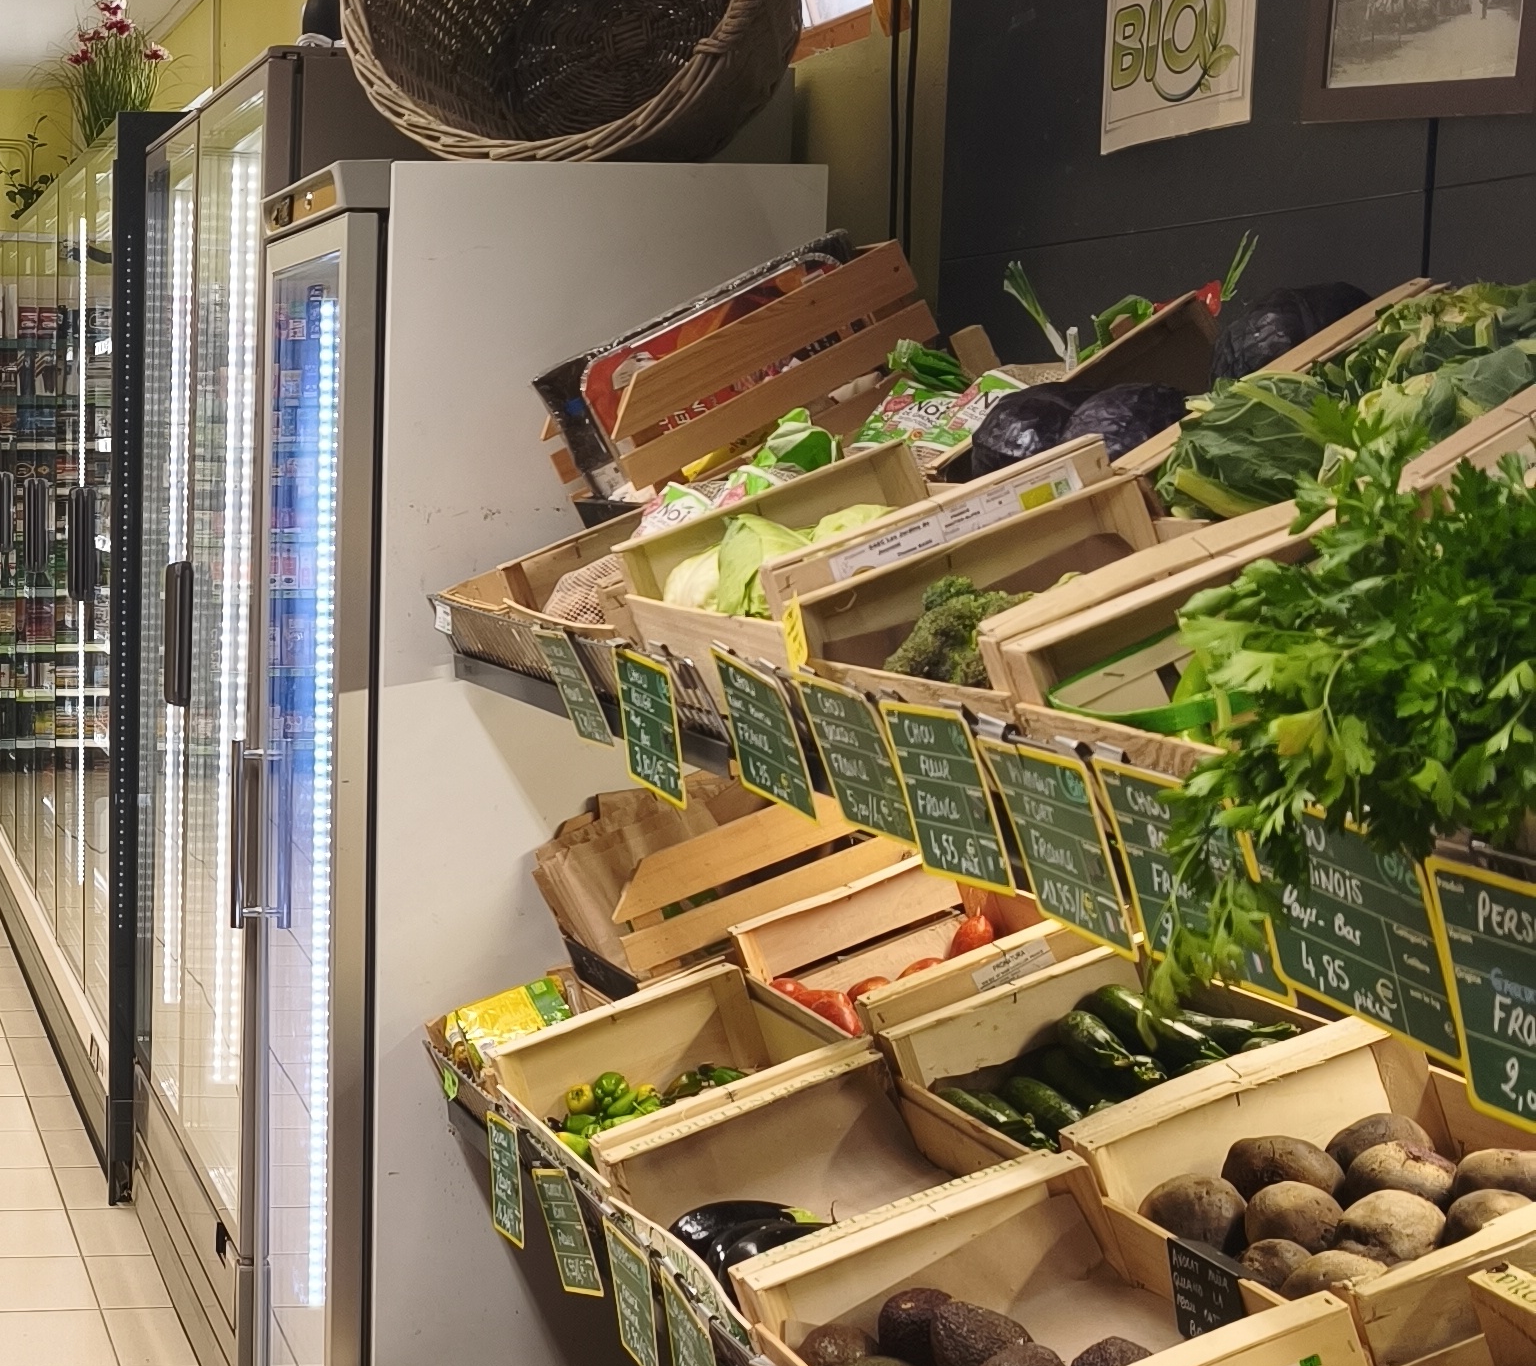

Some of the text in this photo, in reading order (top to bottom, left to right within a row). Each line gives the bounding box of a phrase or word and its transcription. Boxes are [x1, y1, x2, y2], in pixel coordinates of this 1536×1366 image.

[903, 719, 935, 745] CHOU
[1476, 889, 1536, 944] PERS
[1300, 939, 1350, 992] 4,85
